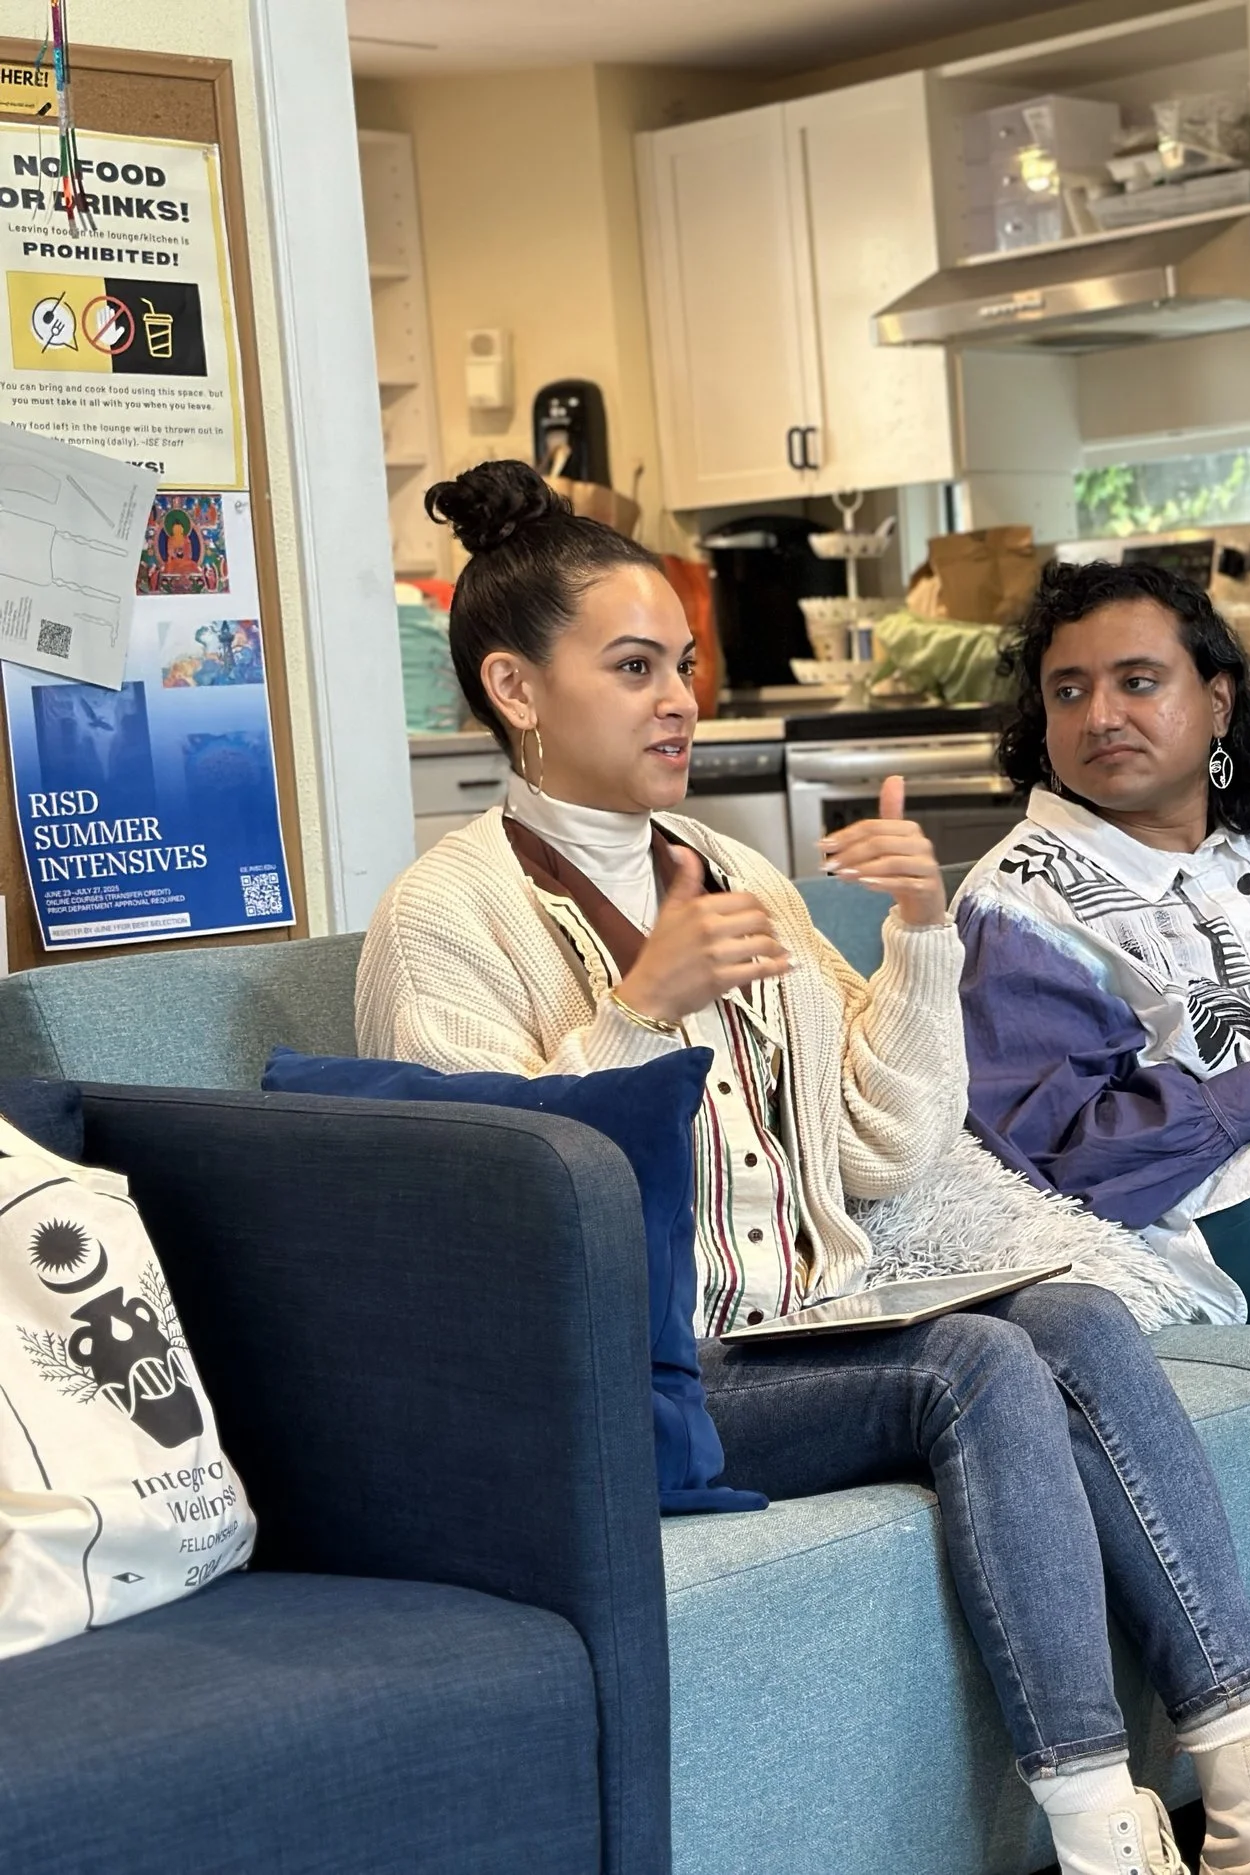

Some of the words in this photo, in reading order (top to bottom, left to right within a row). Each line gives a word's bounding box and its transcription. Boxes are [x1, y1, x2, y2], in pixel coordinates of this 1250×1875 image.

[1, 68, 48, 87] HERE!
[13, 155, 61, 178] NO
[75, 159, 166, 187] FOOD
[0, 187, 45, 210] OR
[8, 223, 48, 236] Leaving
[89, 230, 104, 239] the
[107, 231, 179, 245] lounge/kitchen
[181, 236, 190, 245] is
[23, 242, 179, 266] PROHIBITED!
[0, 382, 17, 391] You
[20, 383, 36, 391] can
[39, 383, 63, 393] bring
[66, 384, 82, 393] and
[85, 385, 106, 393] cook
[109, 386, 129, 394] food
[131, 387, 155, 396] using
[158, 387, 175, 396] this
[178, 389, 206, 398] space,
[209, 389, 223, 398] but
[12, 398, 29, 406] you
[89, 399, 100, 407] all
[103, 400, 123, 408] with
[125, 401, 141, 410] you
[143, 401, 167, 409] when
[169, 403, 185, 411] you
[188, 403, 214, 411] leave.
[30, 421, 50, 430] food
[53, 422, 68, 431] left
[72, 423, 80, 431] in
[83, 423, 97, 431] the
[100, 424, 130, 433] lounge
[133, 425, 149, 433] will
[165, 426, 195, 434] thrown
[68, 438, 105, 447] morning
[108, 438, 139, 448] (daily).
[162, 439, 184, 447] Staff
[29, 790, 99, 818] RISD
[34, 817, 162, 850] SUMMER
[37, 844, 207, 882] INTENSIVES
[45, 890, 61, 898] JUNE
[103, 885, 119, 893] 2025
[46, 897, 70, 906] ONLINE
[71, 895, 103, 904] COURSES
[105, 891, 142, 901] (TRANSFER
[144, 888, 171, 897] CREDIT)
[47, 906, 68, 914] PRIOR
[69, 902, 113, 912] DEPARTMENT
[114, 899, 150, 907] APPROVAL
[151, 895, 185, 905] REQUIRED
[167, 1485, 236, 1523] Wellnss
[180, 1520, 238, 1553] FELLOWSHIP
